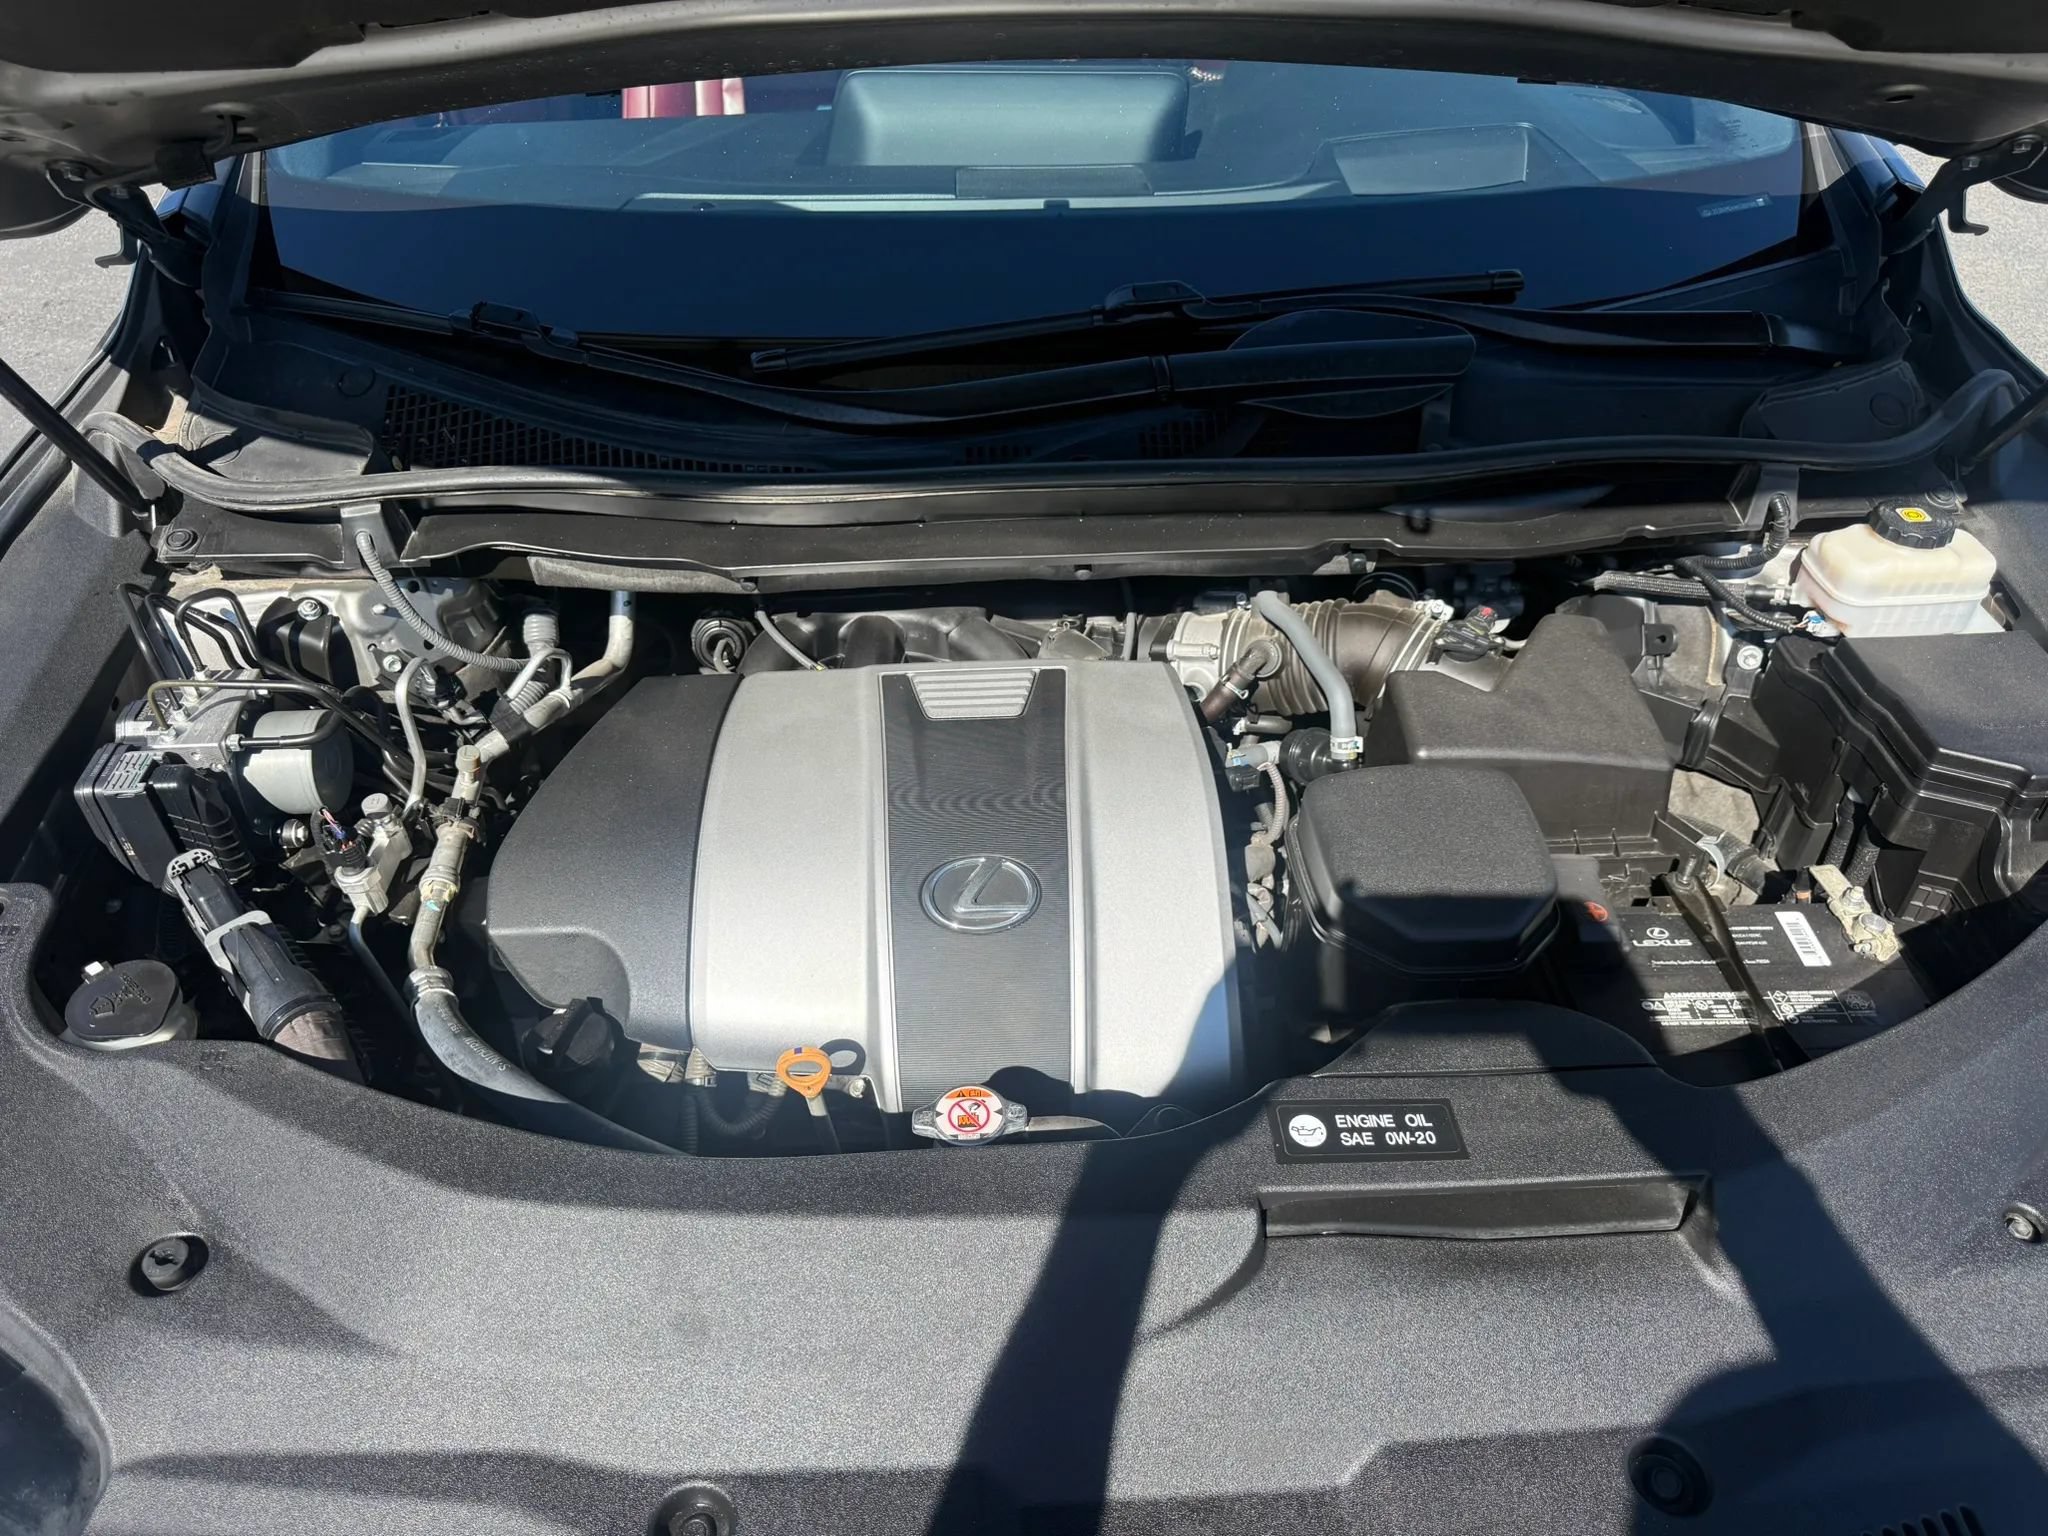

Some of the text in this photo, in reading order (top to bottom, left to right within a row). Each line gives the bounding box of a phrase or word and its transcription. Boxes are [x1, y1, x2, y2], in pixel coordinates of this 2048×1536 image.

[1632, 939, 1693, 947] LEXUS
[1335, 1113, 1433, 1128] ENGINE OIL
[1340, 1131, 1437, 1146] SAE 0W-20
